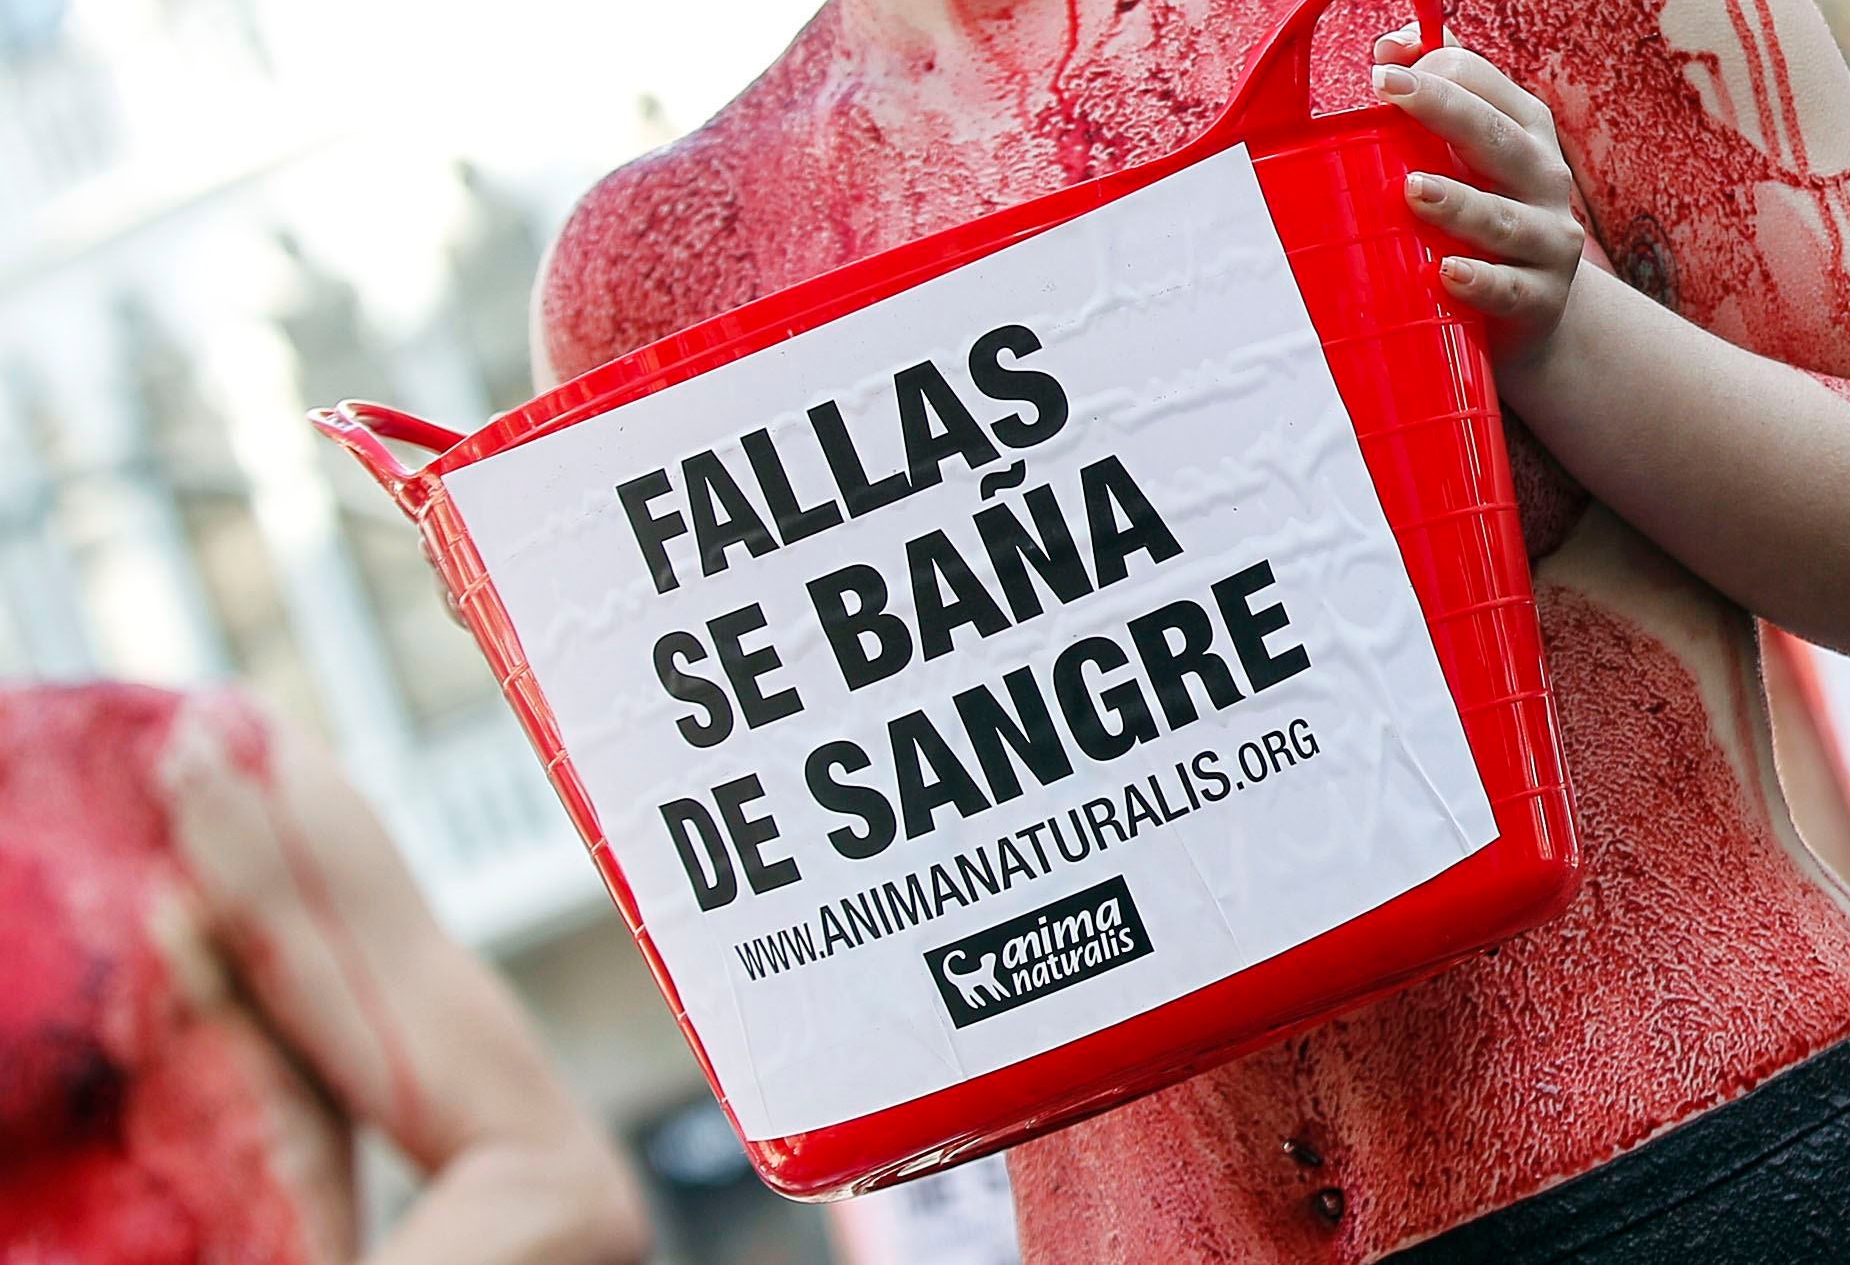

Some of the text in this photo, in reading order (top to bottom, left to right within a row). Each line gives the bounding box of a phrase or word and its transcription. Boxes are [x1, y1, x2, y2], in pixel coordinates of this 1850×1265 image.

[616, 323, 1069, 593] FALLAS
[652, 455, 1184, 749] SE BAÑA
[659, 560, 1311, 912] DE SANGRE
[736, 719, 1319, 980] WWW.ANIMANATURALIS.ORG
[1002, 897, 1122, 969] anima
[1011, 927, 1135, 996] naturalis
